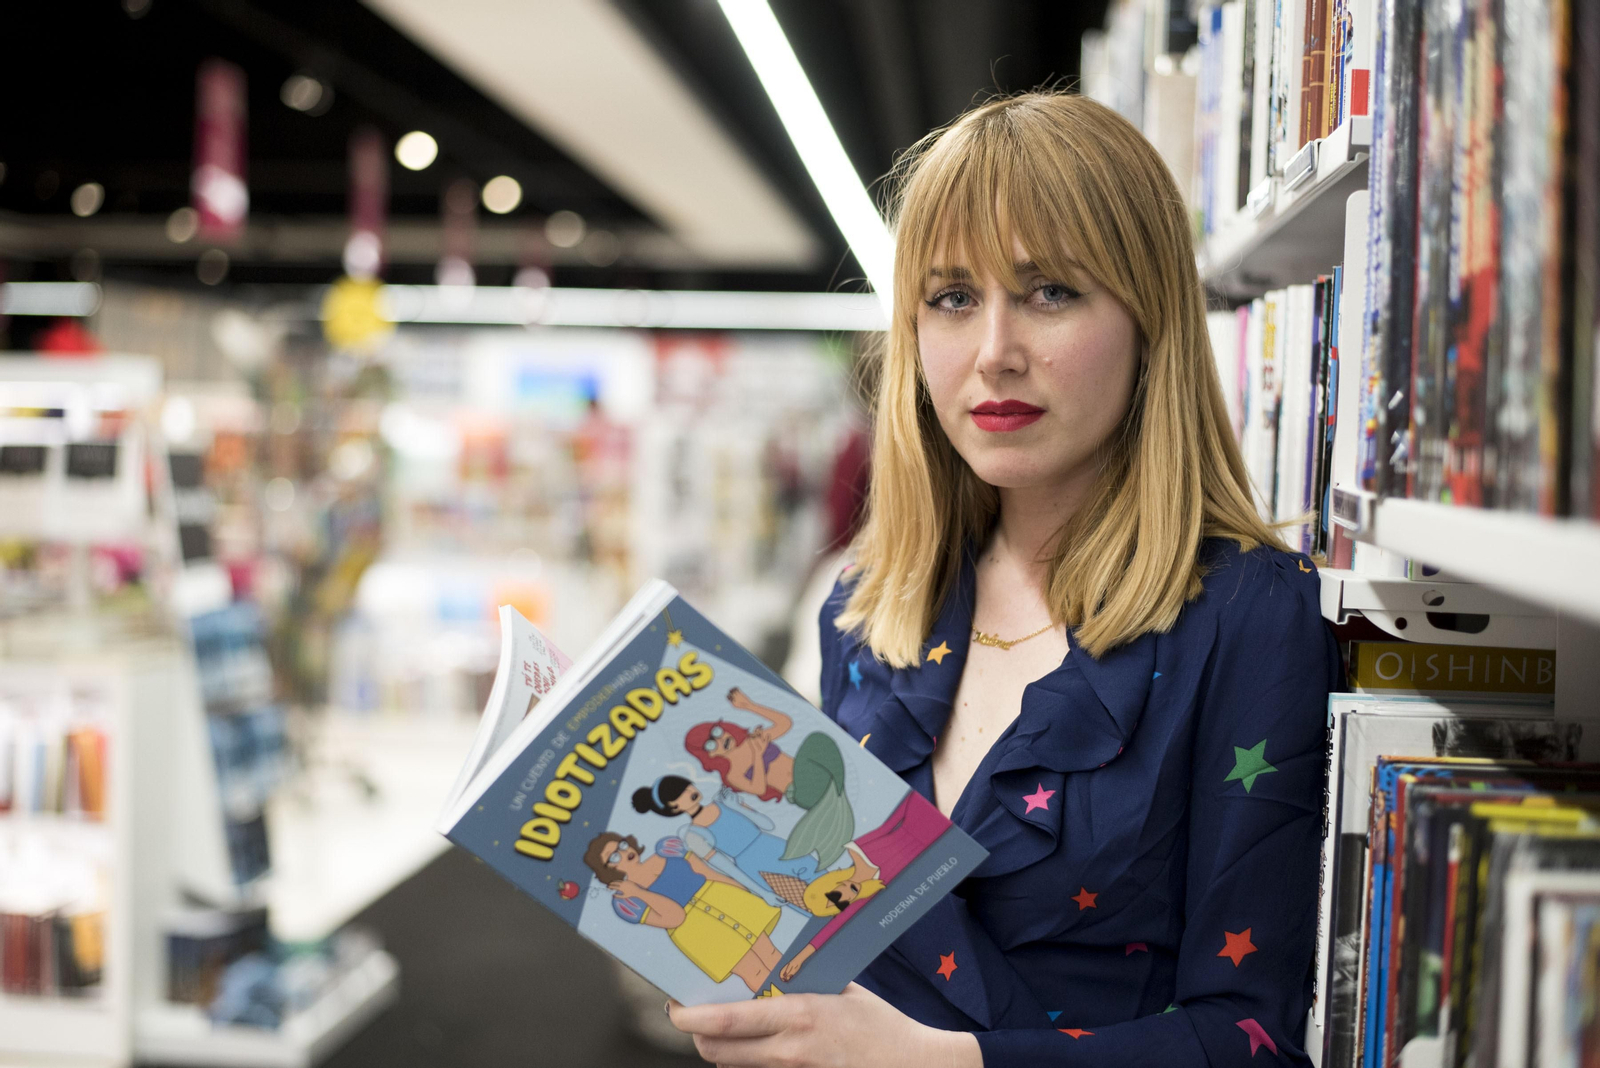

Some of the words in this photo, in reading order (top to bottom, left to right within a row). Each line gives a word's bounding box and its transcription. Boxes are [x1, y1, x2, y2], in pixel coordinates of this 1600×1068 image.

[510, 791, 527, 811] UN
[521, 749, 555, 791] CUENTO
[551, 730, 570, 749] DE
[566, 661, 649, 731] EMPODERHADAS
[514, 651, 714, 861] IDIOTIZADAS
[878, 894, 918, 928] MODERNA
[914, 882, 930, 895] DE
[926, 857, 958, 886] PUEBLO
